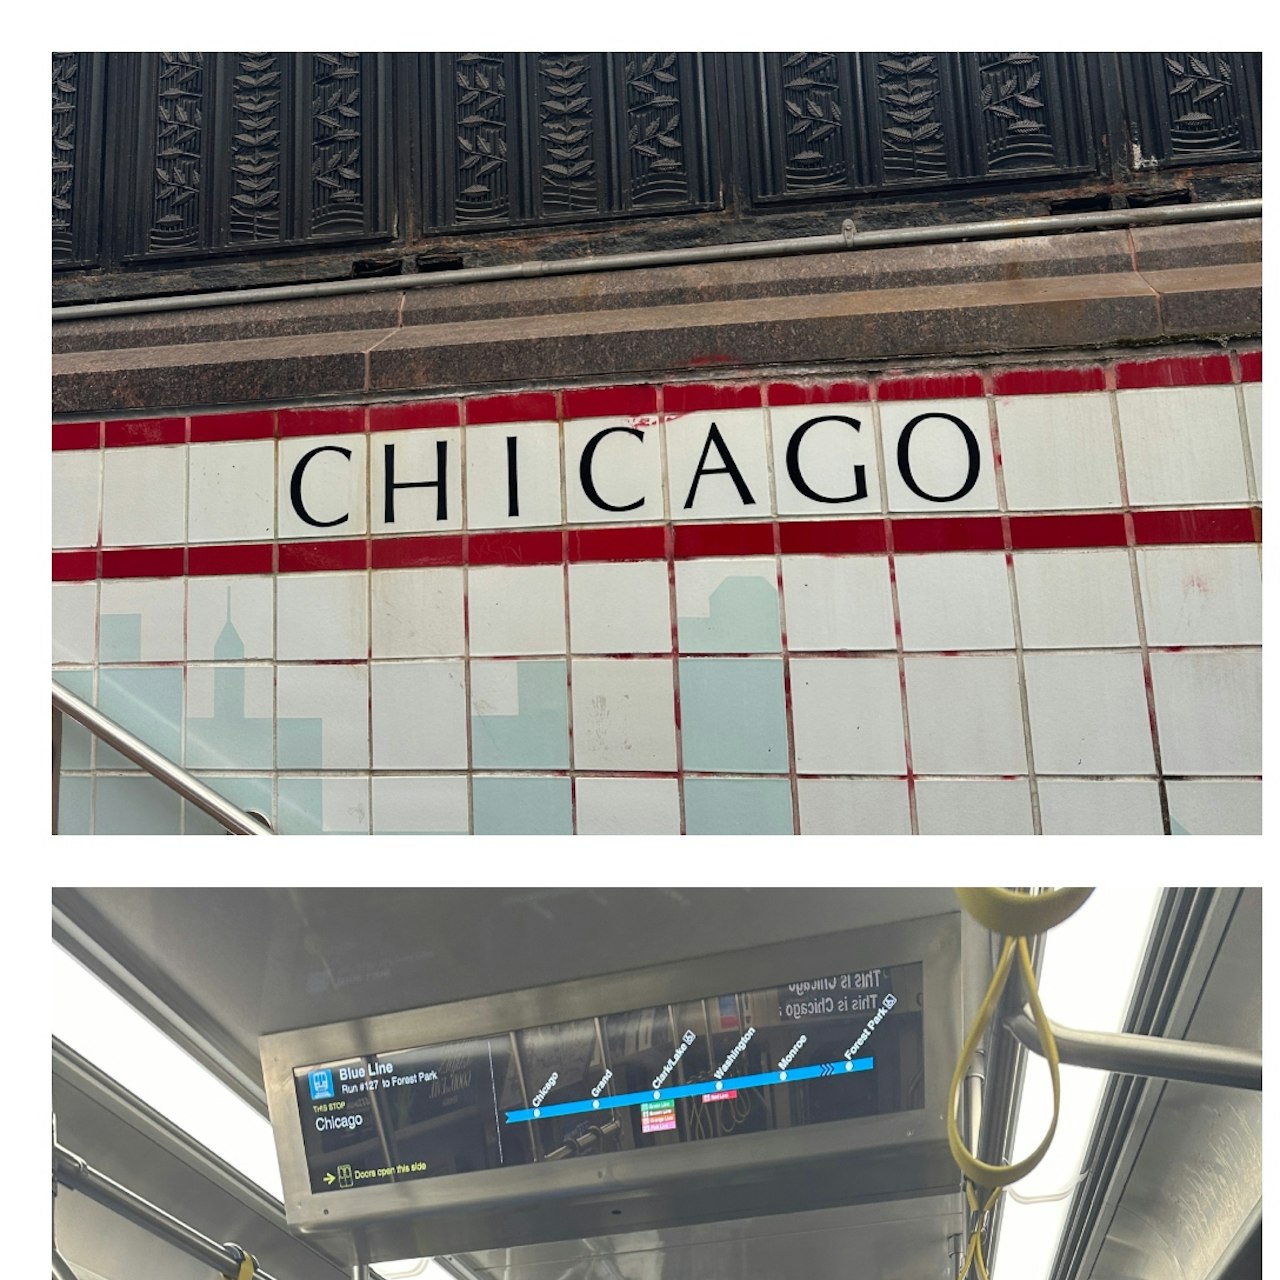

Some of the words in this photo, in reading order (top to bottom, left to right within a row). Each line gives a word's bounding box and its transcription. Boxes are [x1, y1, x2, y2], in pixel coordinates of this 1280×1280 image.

[289, 412, 981, 528] CHICAGO
[844, 1028, 870, 1061] Forest
[866, 1006, 889, 1032] Park
[652, 1042, 688, 1090] Clark/Lake
[713, 1026, 756, 1080] Washington
[777, 1034, 808, 1070] Monroe
[340, 1067, 366, 1081] Blue
[367, 1062, 394, 1077] Line
[341, 1084, 358, 1095] Run
[359, 1079, 379, 1093] #127
[382, 1079, 390, 1088] to
[392, 1075, 417, 1087] Forest
[418, 1070, 438, 1082] Park
[590, 1068, 613, 1098] Grand
[328, 1101, 346, 1111] STOP
[532, 1071, 560, 1108] Chicago
[315, 1114, 363, 1131] Chicago
[354, 1169, 376, 1180] Doors
[377, 1166, 395, 1178] open
[396, 1164, 410, 1174] this
[411, 1161, 427, 1173] side
